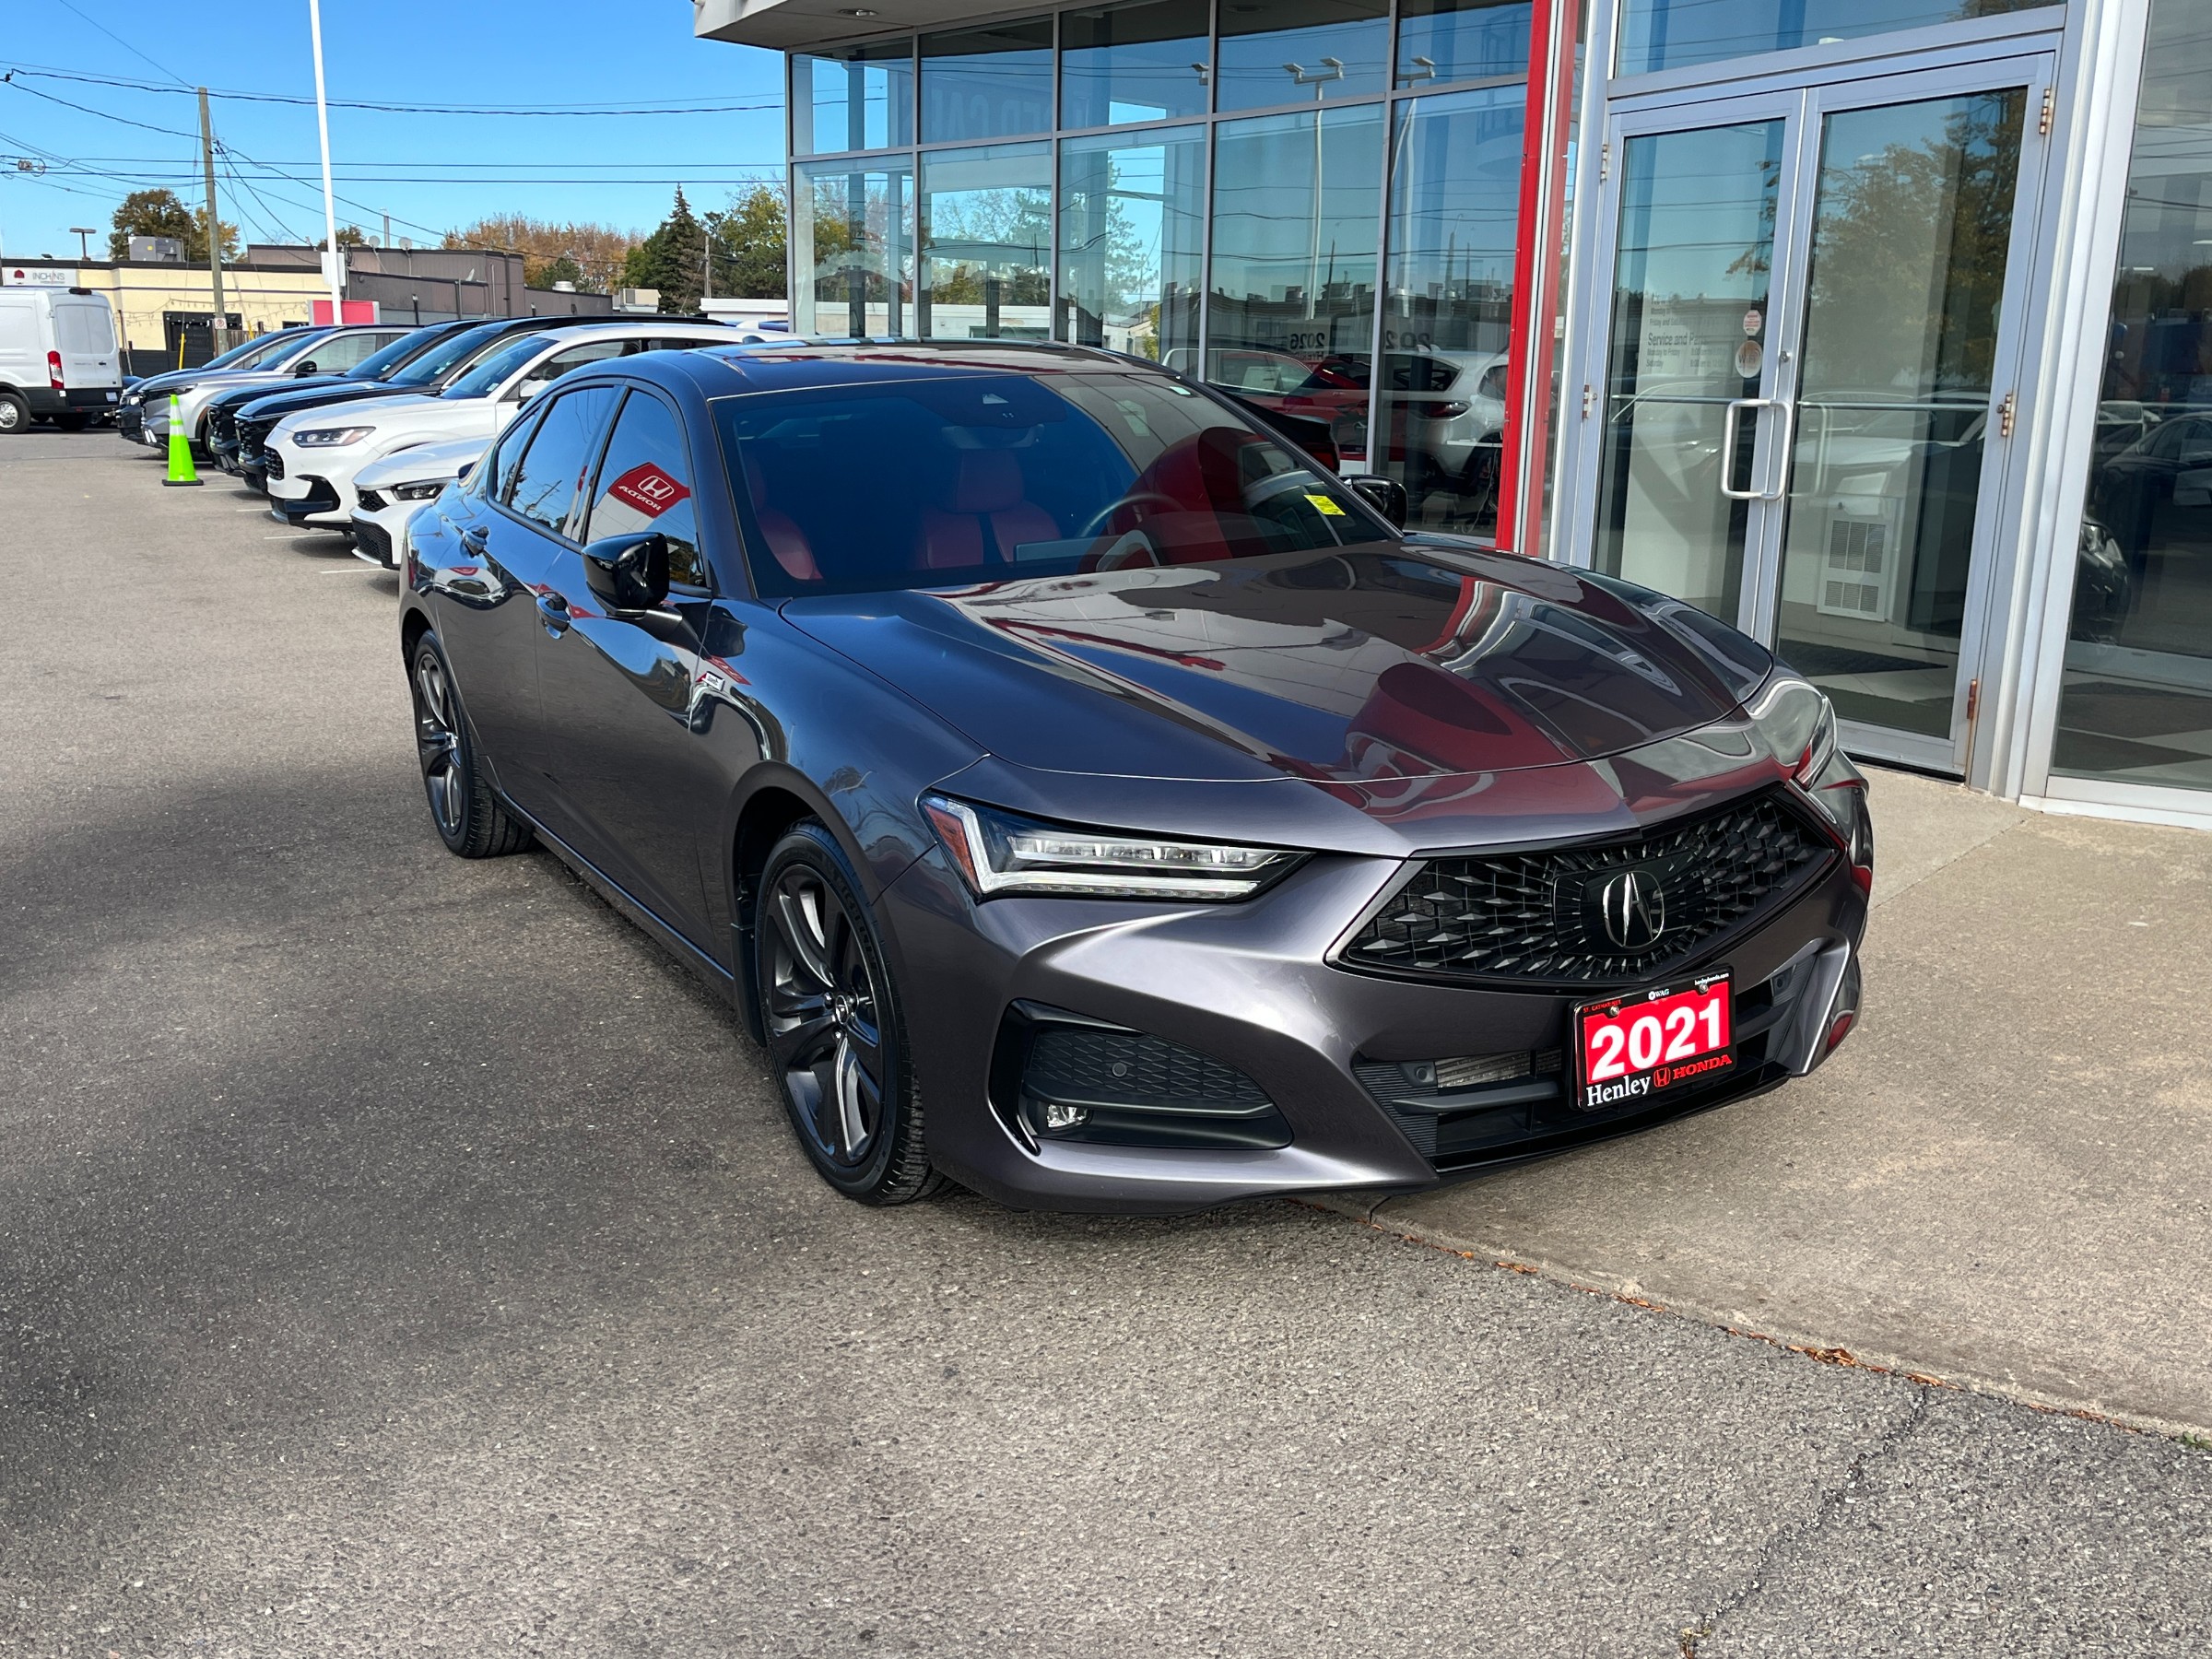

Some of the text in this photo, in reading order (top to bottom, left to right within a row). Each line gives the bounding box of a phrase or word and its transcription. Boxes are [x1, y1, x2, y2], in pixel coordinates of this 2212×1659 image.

[1647, 332, 1673, 346] Service
[1674, 332, 1688, 346] and
[1591, 998, 1720, 1080] 2021
[1586, 1054, 1732, 1106] Henley HONDA
